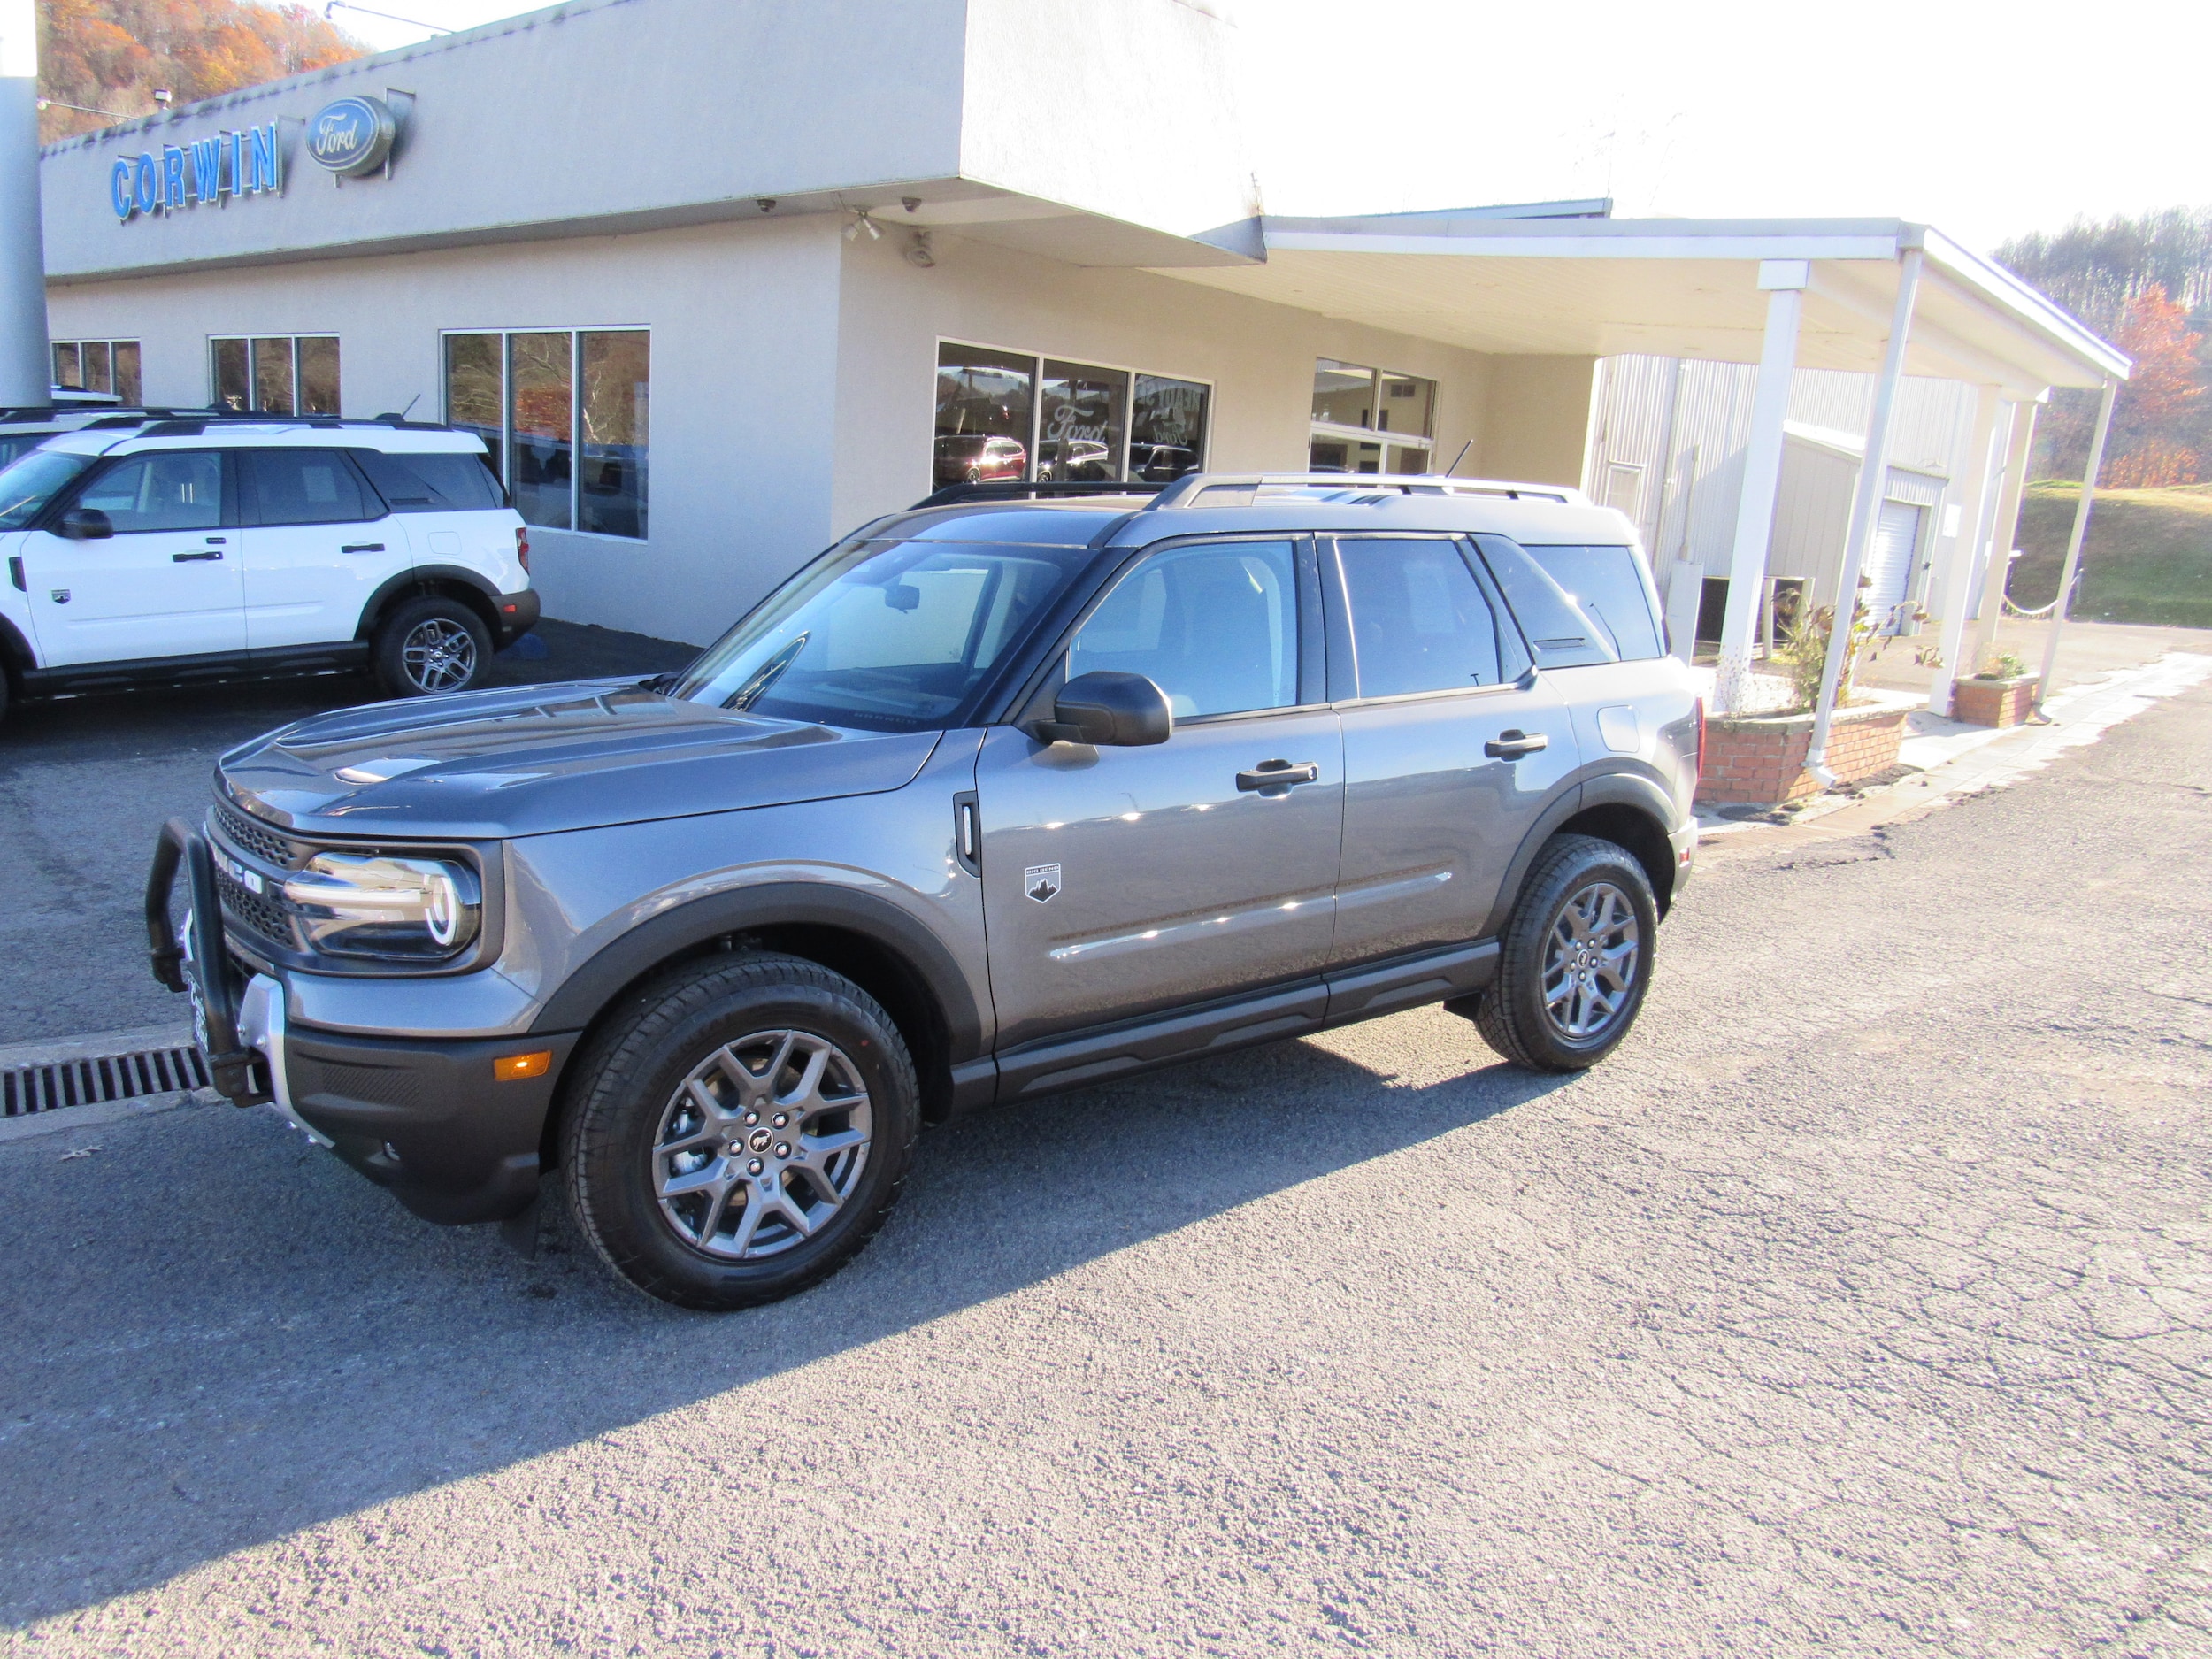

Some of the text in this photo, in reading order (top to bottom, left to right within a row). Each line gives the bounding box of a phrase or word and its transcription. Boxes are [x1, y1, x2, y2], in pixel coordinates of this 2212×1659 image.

[317, 113, 358, 155] Ford
[111, 121, 277, 220] CORWIN
[1047, 404, 1108, 442] Ford
